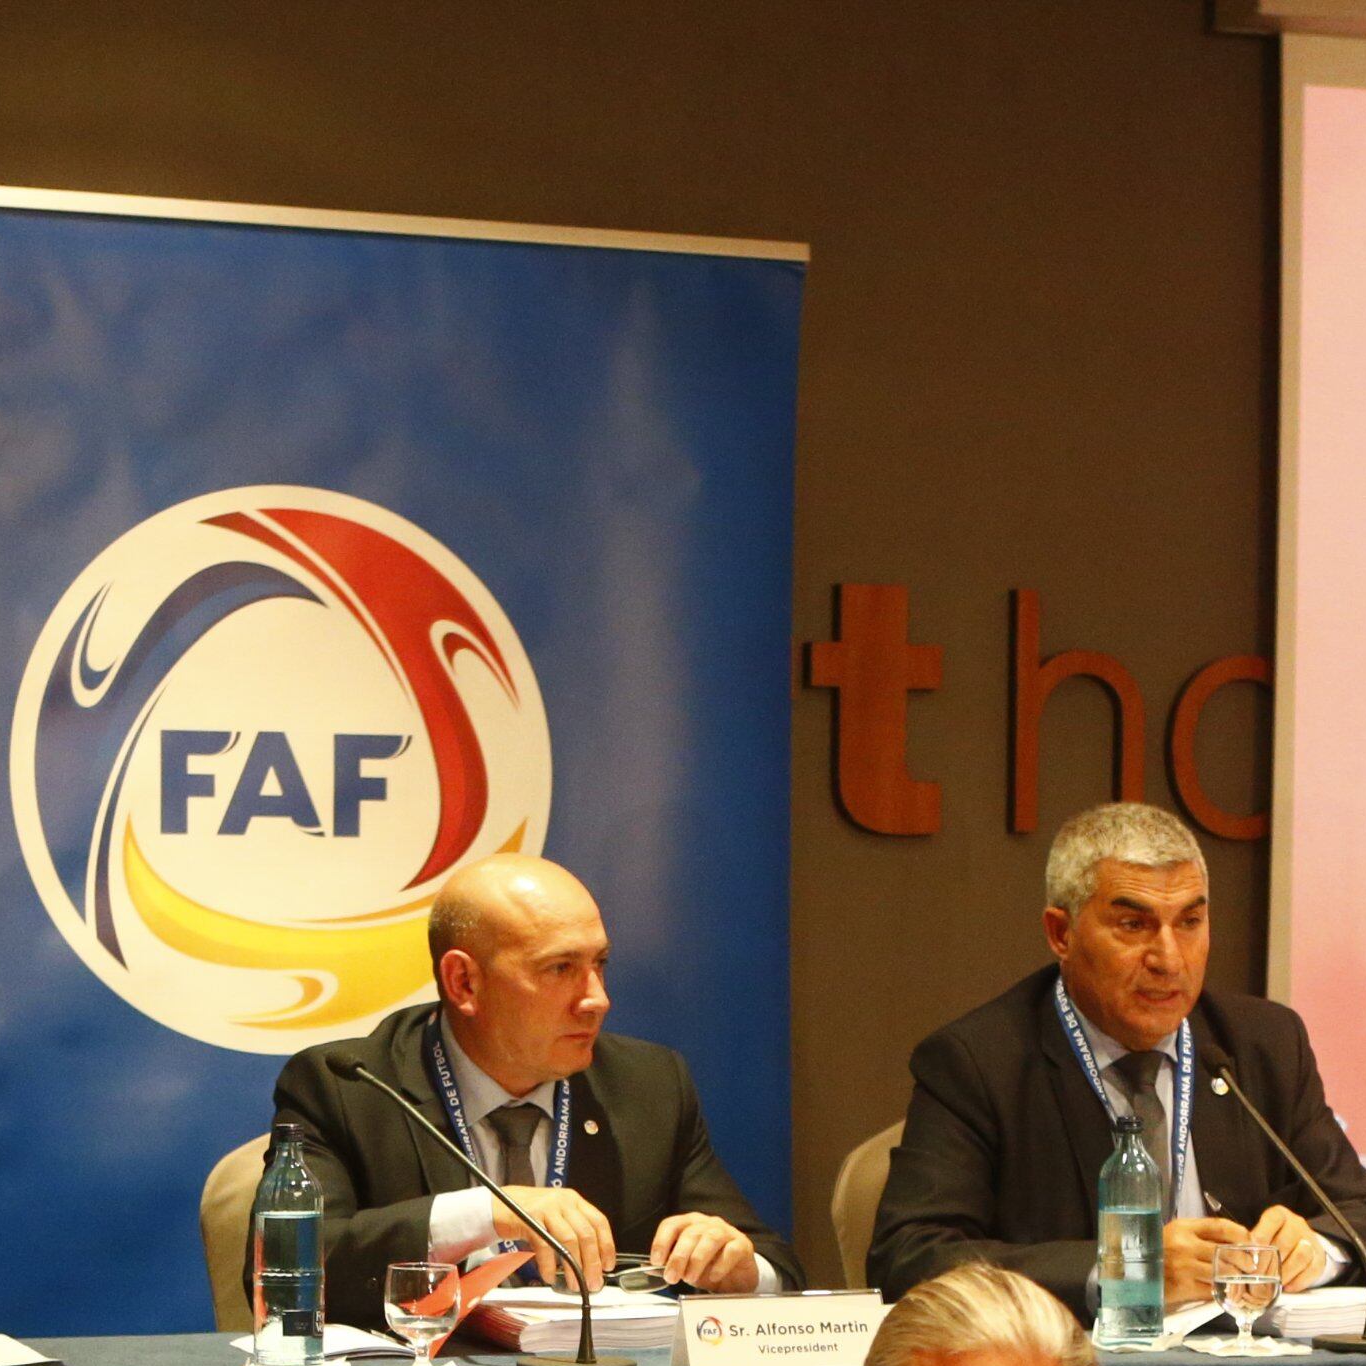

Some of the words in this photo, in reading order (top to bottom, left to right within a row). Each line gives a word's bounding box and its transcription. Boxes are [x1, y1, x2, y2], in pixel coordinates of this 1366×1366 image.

[160, 730, 412, 838] FAF
[1065, 1011, 1079, 1029] DE
[434, 1041, 453, 1088] FUTBOL
[1182, 1056, 1193, 1073] DE
[446, 1088, 460, 1107] DE
[1178, 1076, 1192, 1151] ANDORRANA
[553, 1096, 570, 1176] ANDORRANA
[729, 1325, 750, 1337] Sr.
[755, 1322, 815, 1336] Alfonso
[758, 1343, 838, 1355] Vicepresident
